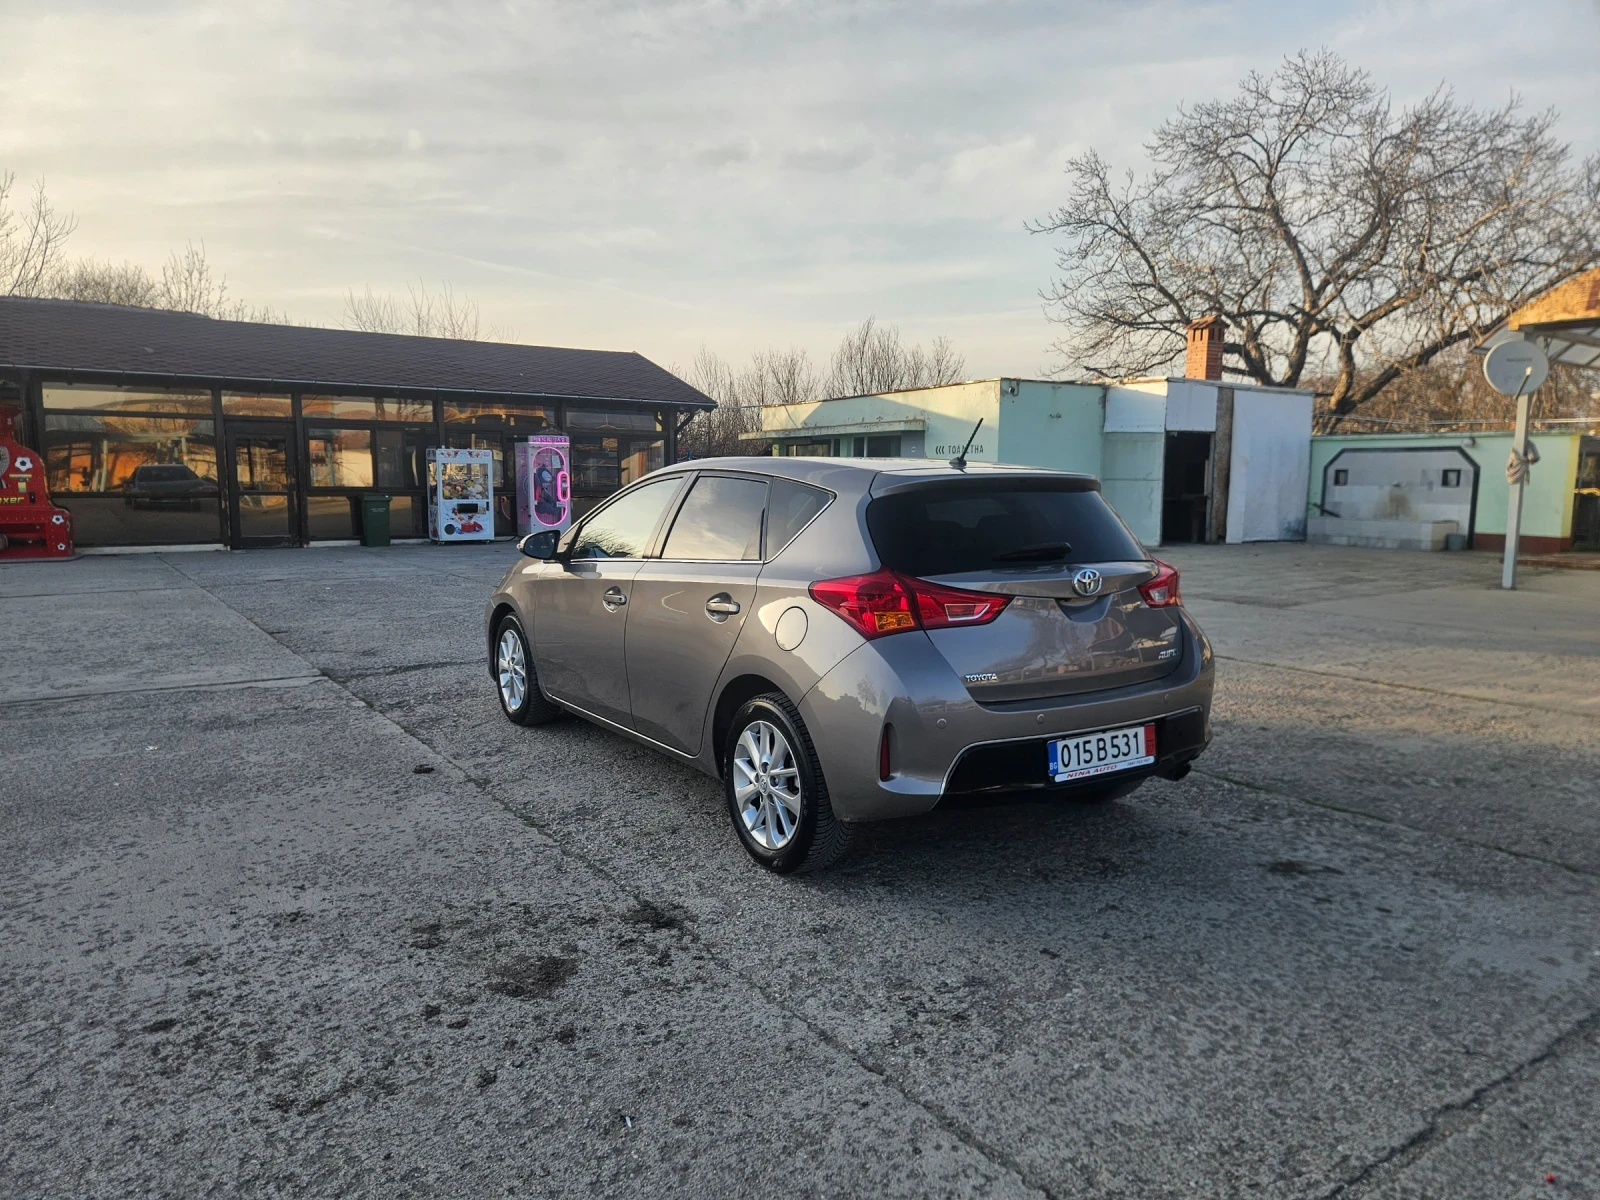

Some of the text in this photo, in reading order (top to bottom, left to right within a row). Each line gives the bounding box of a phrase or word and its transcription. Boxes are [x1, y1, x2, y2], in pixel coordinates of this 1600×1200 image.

[948, 444, 984, 454] ТОАЛТНА
[964, 673, 998, 682] TOYOTA
[1061, 731, 1139, 768] 015B531
[1049, 762, 1058, 771] BG
[1066, 764, 1118, 779] NINA AUTO
